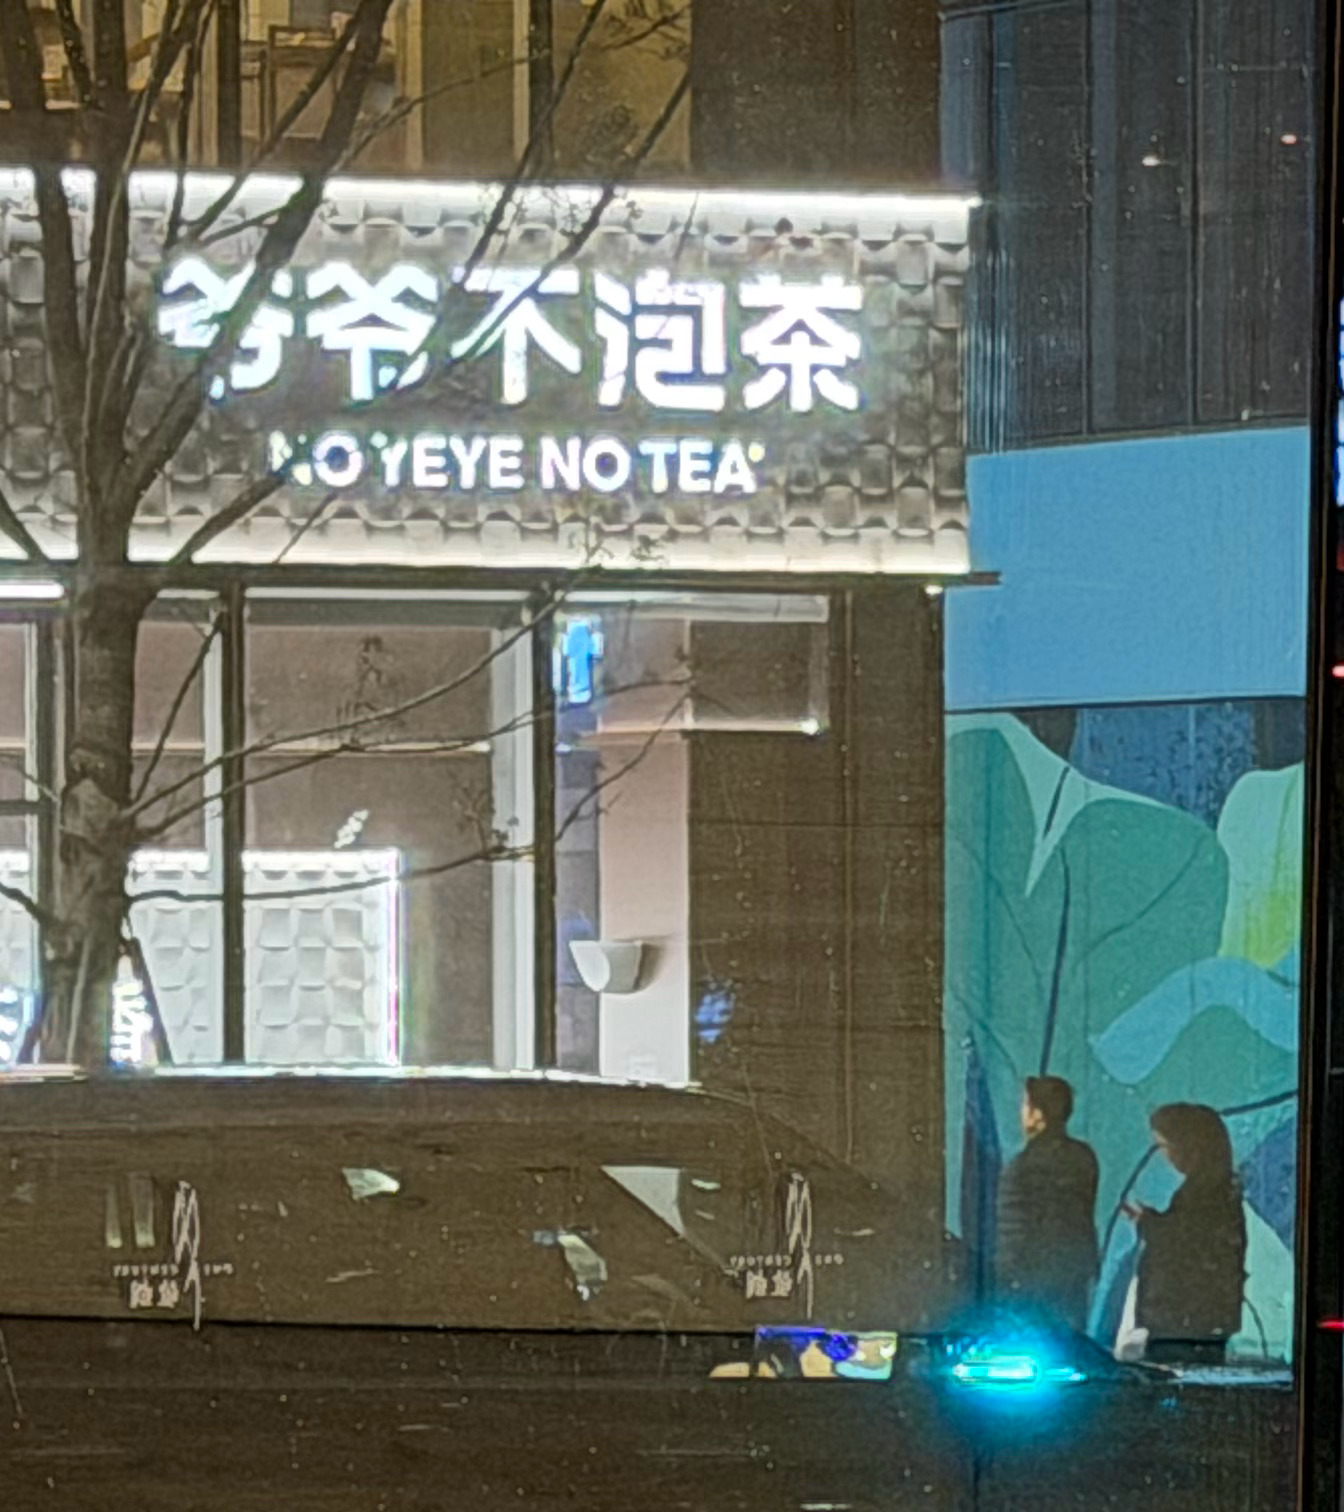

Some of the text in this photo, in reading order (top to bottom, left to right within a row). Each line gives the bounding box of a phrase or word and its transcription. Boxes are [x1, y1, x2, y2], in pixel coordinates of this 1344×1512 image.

[369, 431, 525, 489] YEYE
[540, 436, 630, 491] NO
[639, 437, 758, 493] TEA
